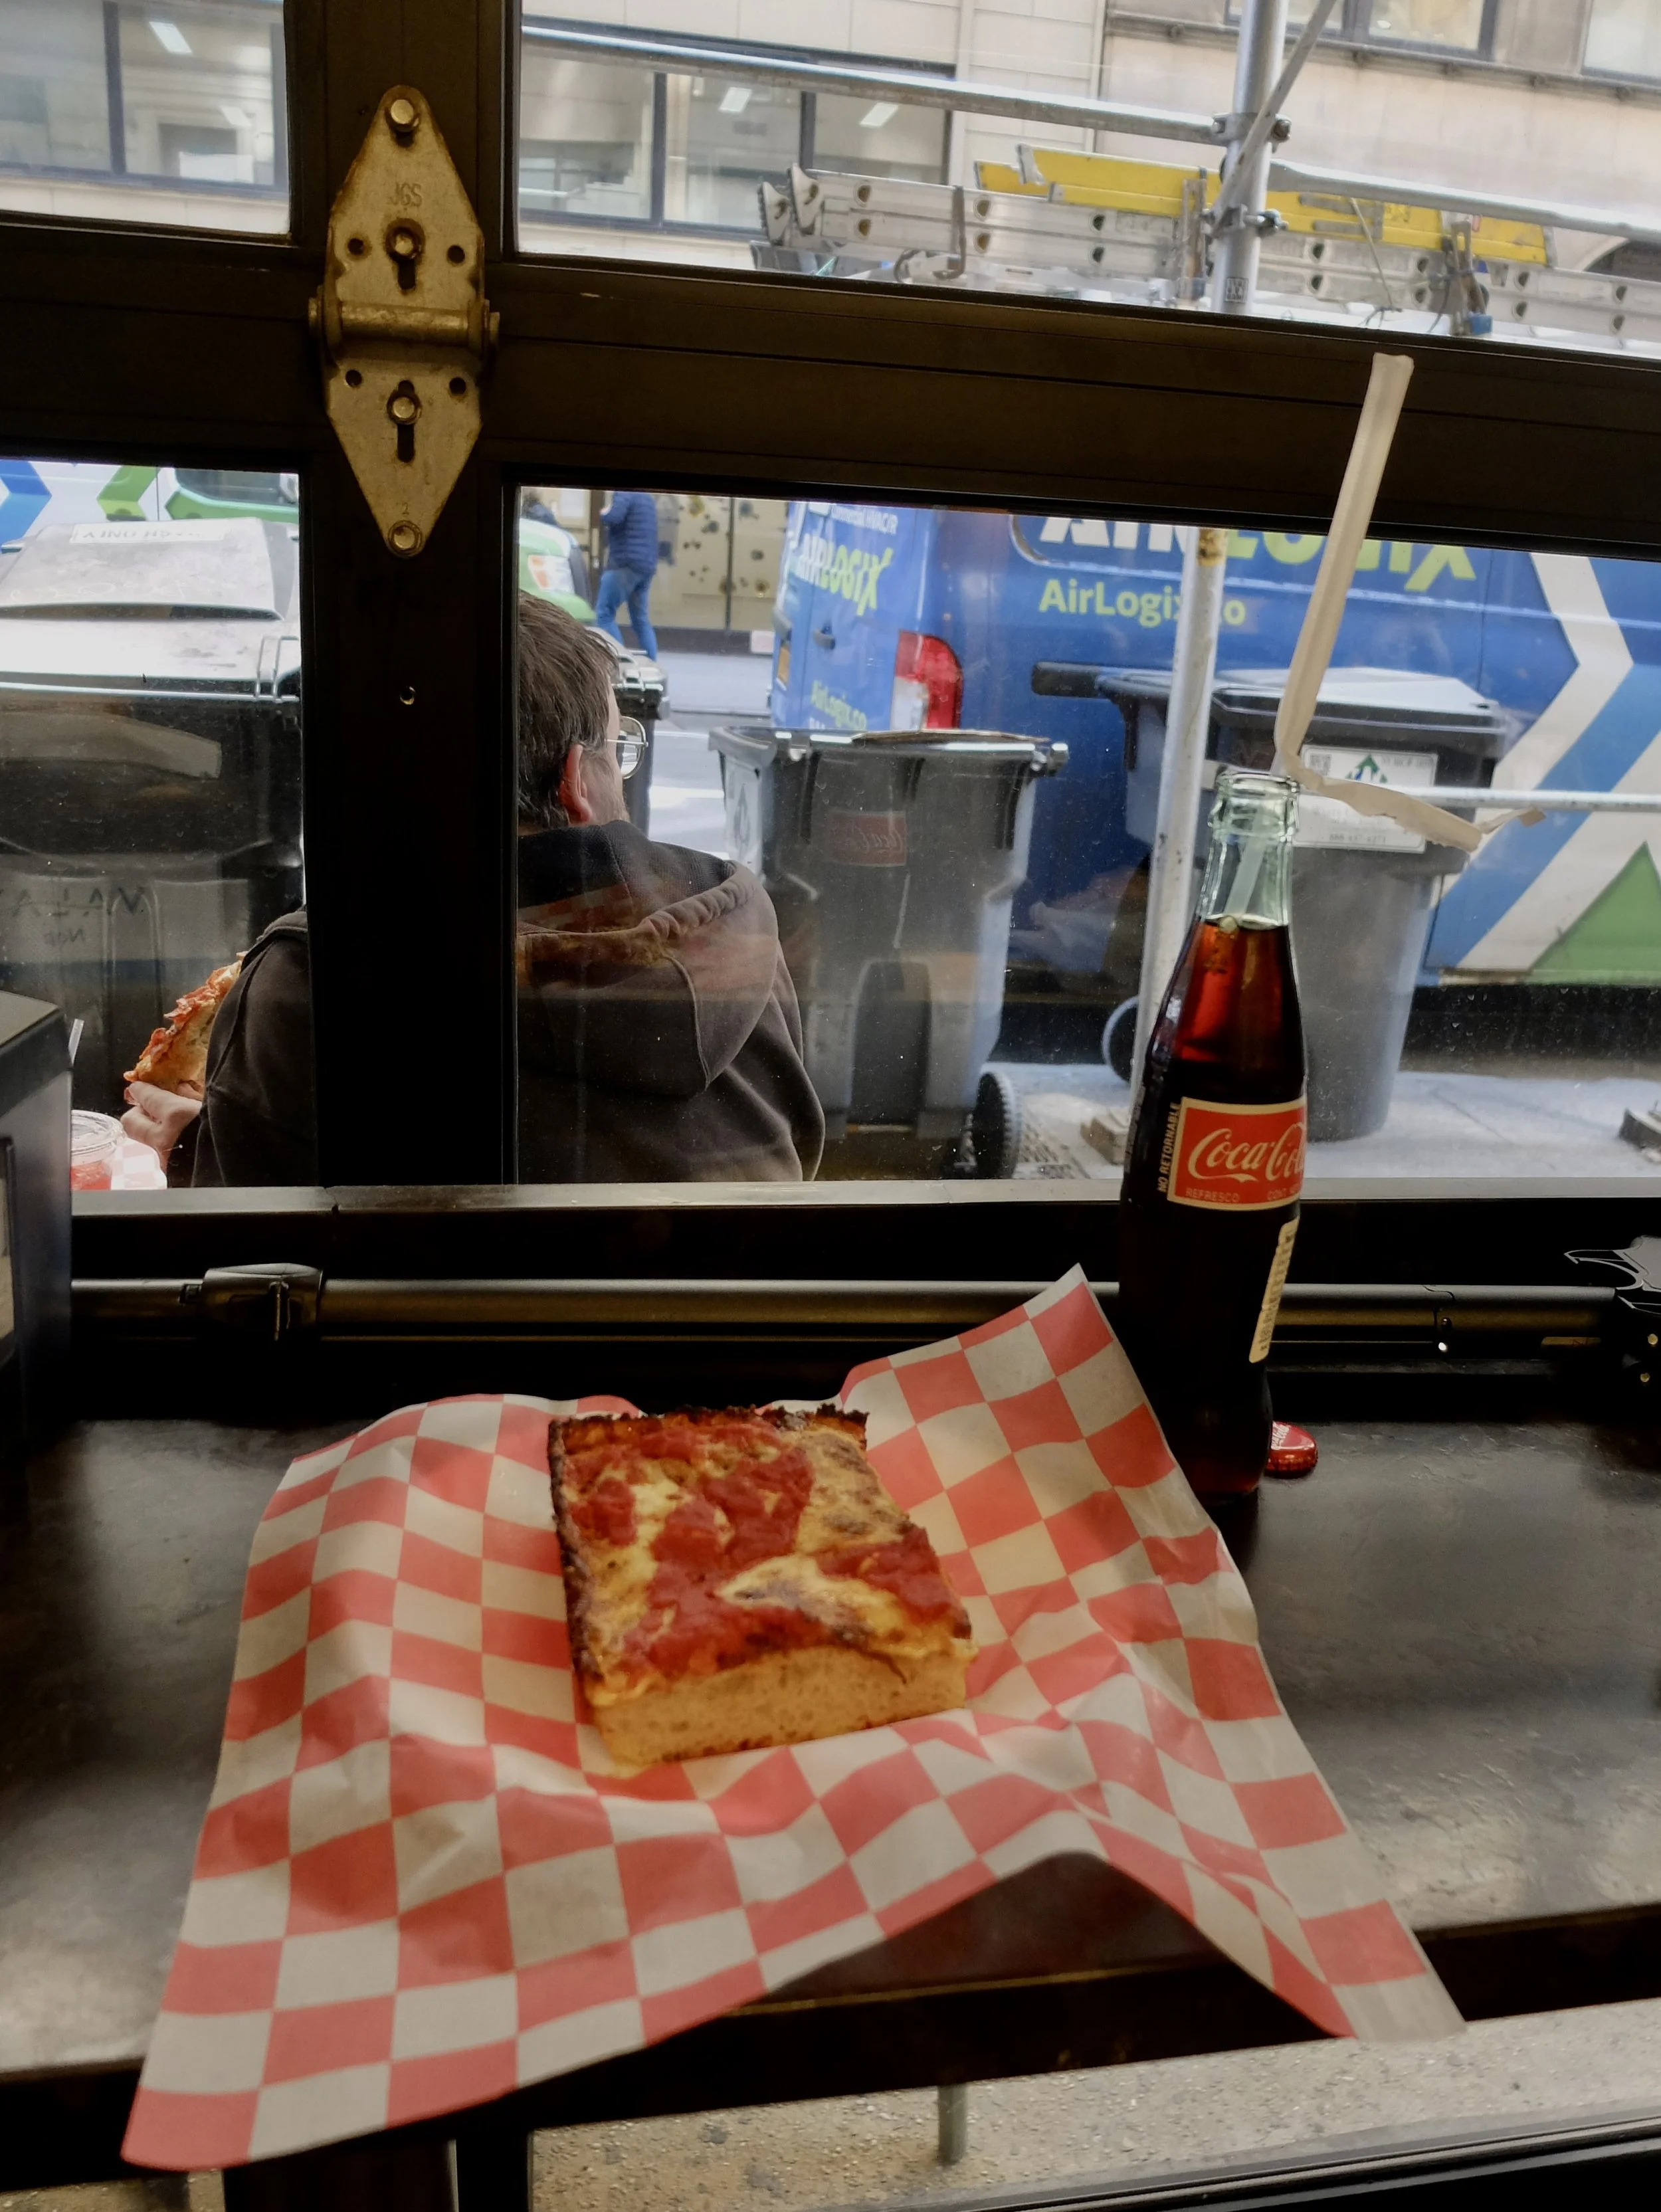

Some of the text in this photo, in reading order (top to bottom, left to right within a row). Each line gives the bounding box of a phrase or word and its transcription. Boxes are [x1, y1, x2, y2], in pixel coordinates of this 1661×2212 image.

[795, 534, 893, 615] AIRLOGIX
[1039, 579, 1246, 627] AirLogio
[1157, 1102, 1181, 1192] NO RETORNABLE
[1185, 1187, 1240, 1203] REFRESCO
